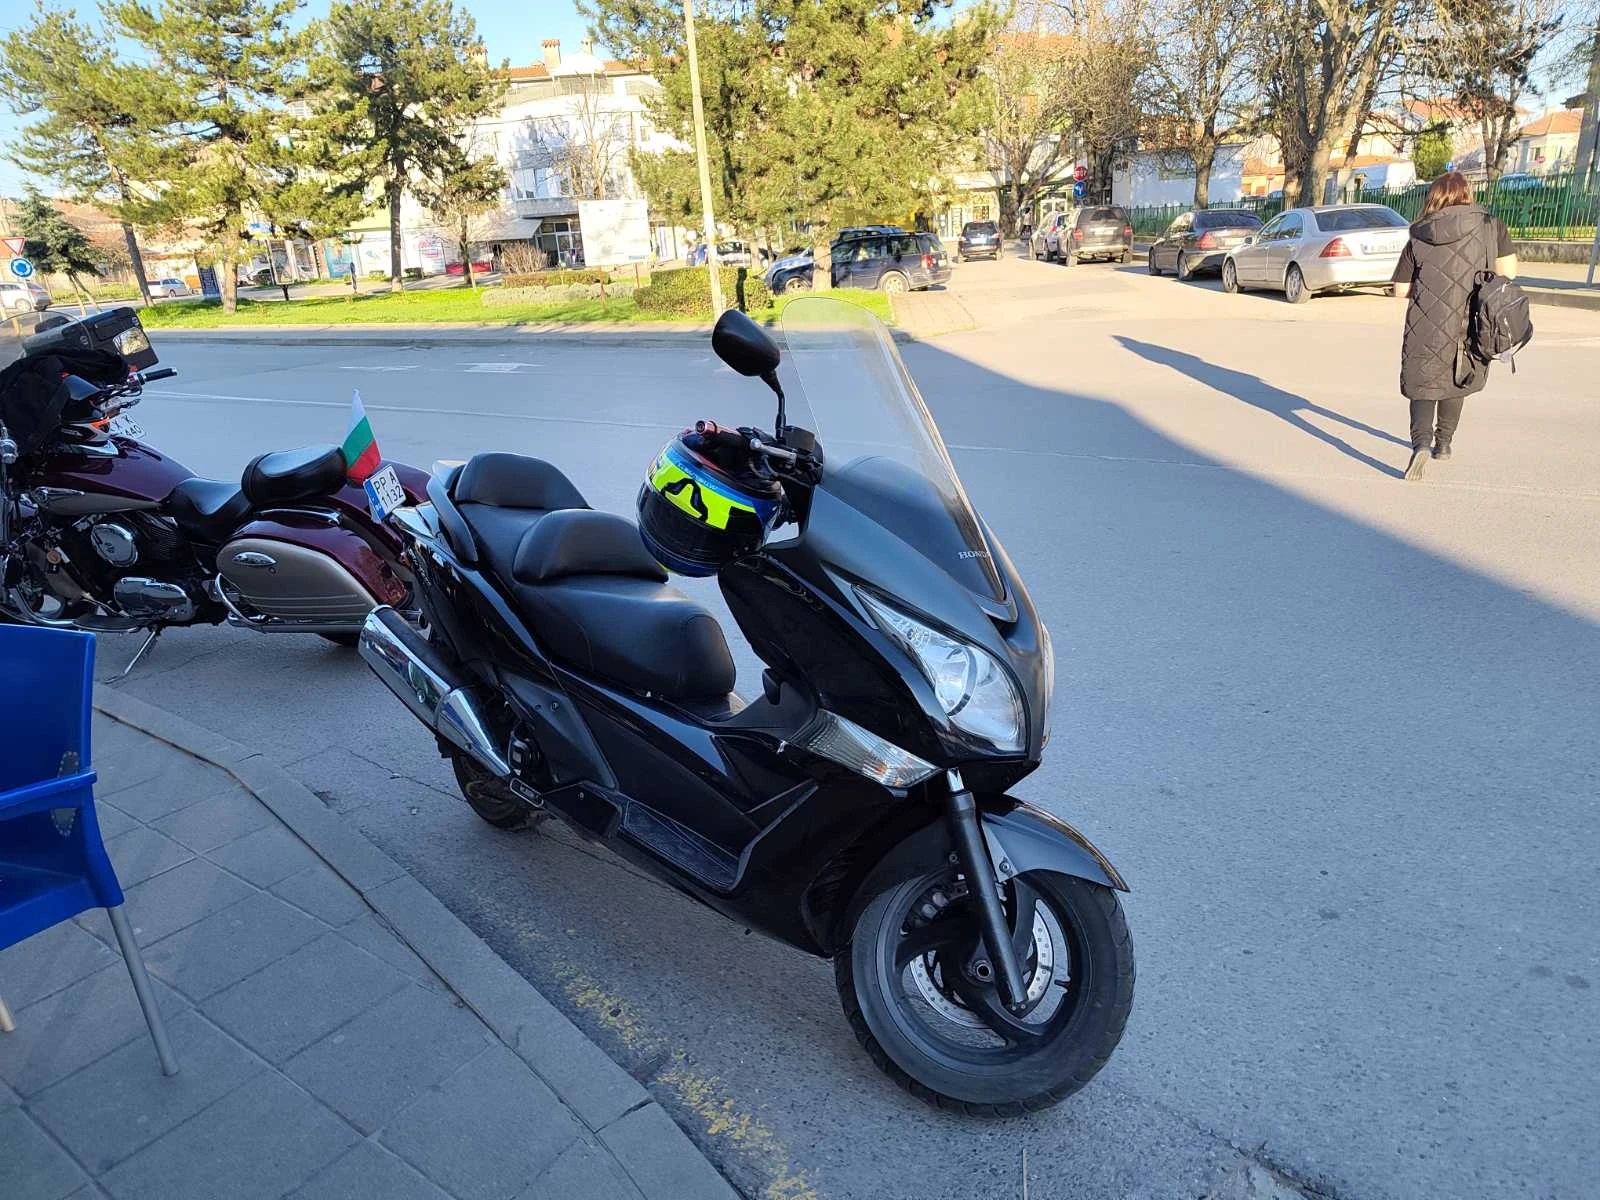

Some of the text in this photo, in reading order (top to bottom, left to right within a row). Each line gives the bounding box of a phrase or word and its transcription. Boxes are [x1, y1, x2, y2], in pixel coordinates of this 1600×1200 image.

[373, 470, 397, 494] PP A
[381, 485, 404, 509] 1132
[958, 550, 988, 560] HOND
